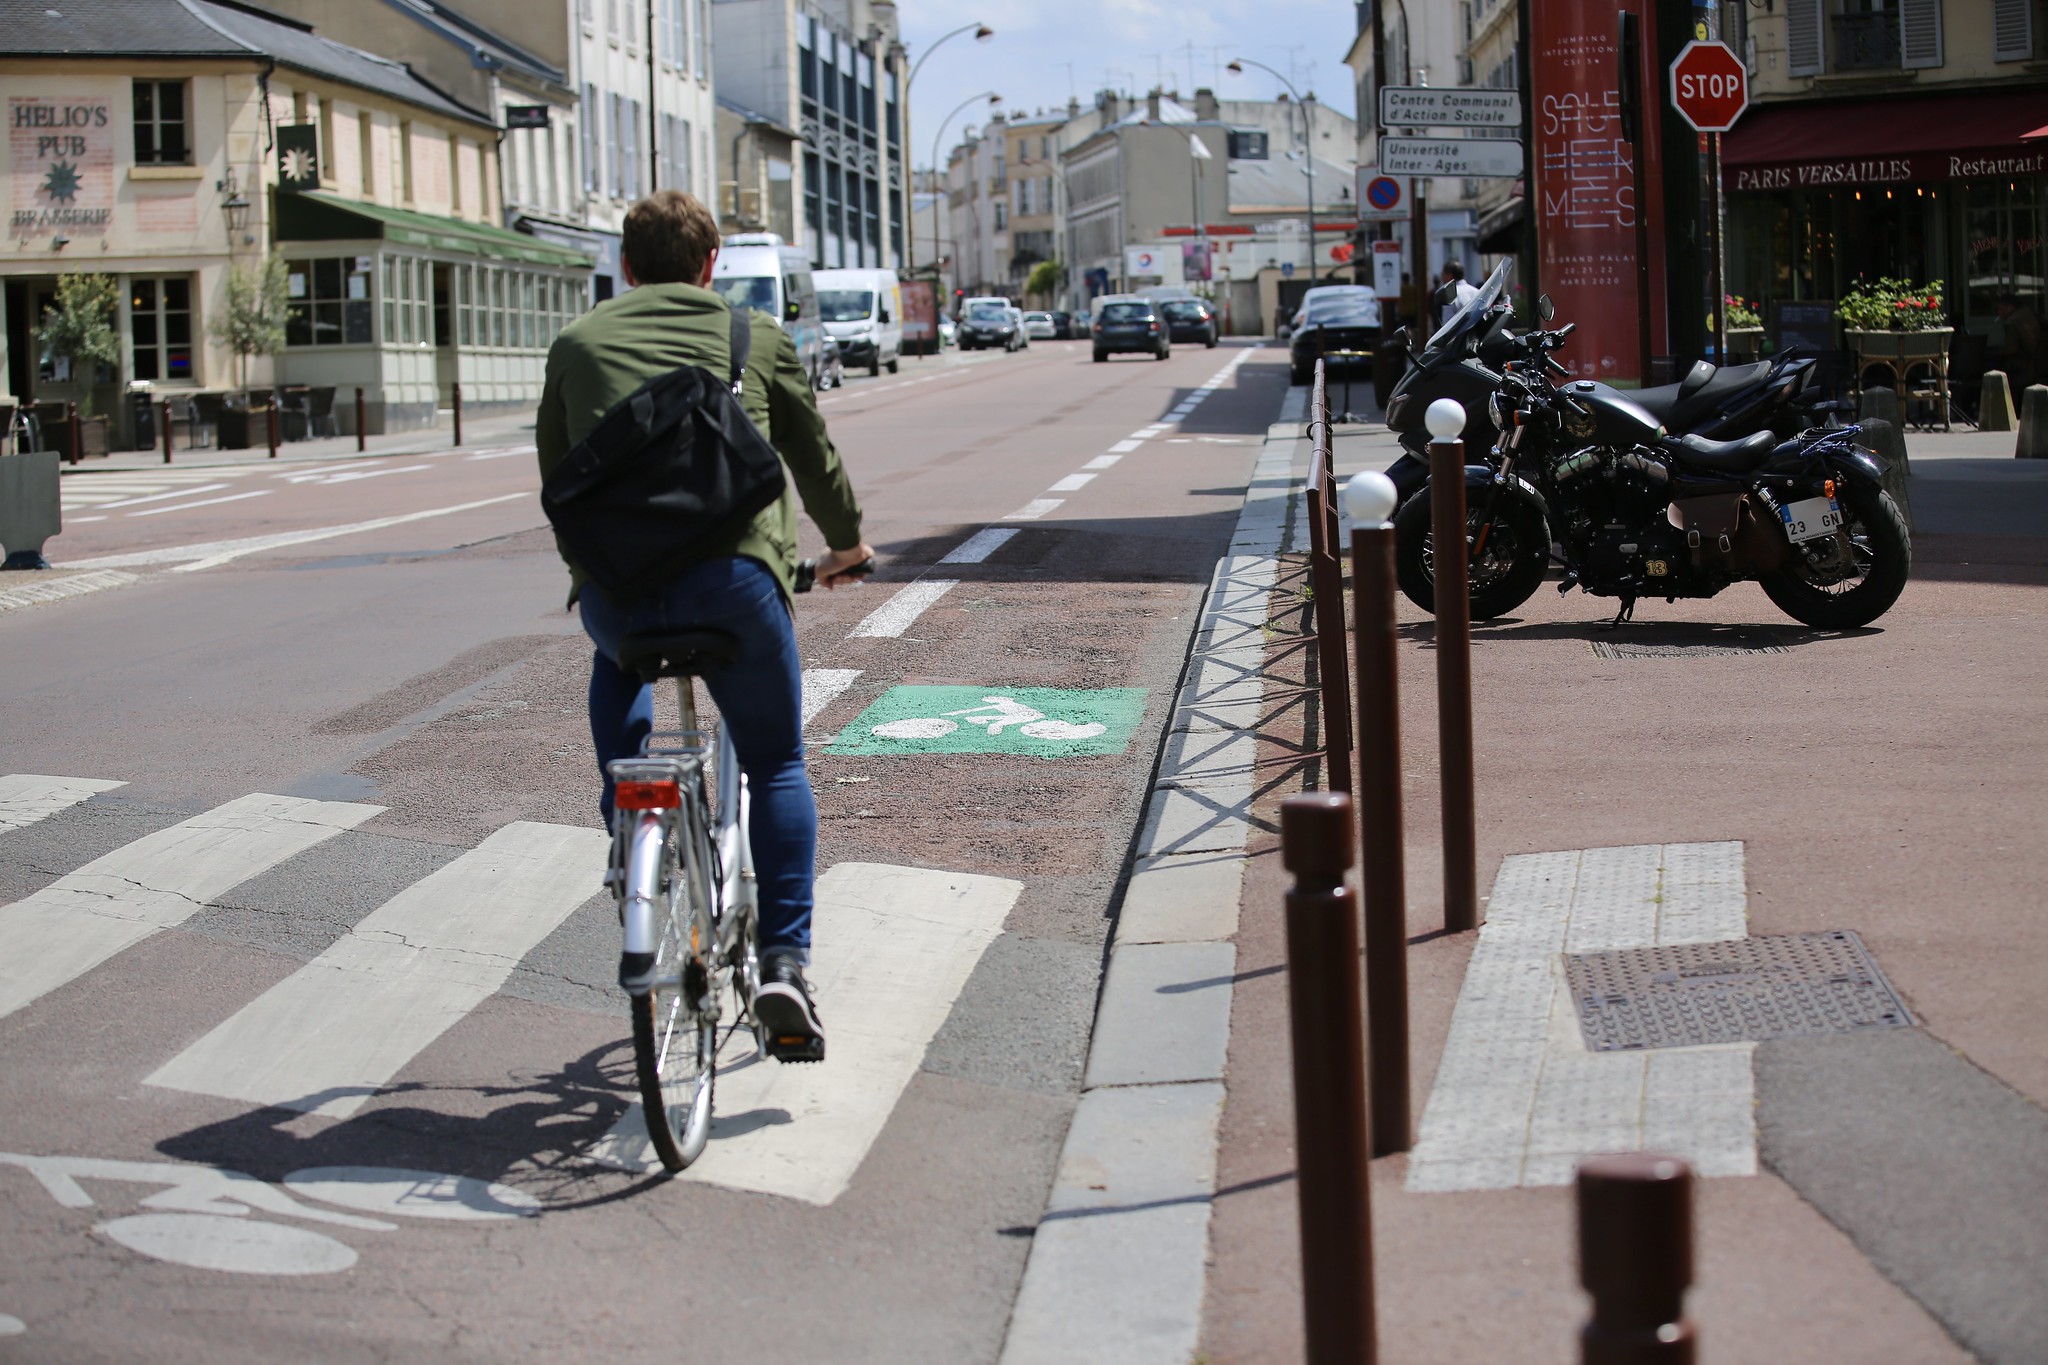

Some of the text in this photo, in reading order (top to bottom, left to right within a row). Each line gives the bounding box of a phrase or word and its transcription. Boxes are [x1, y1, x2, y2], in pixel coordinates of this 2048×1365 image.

[1542, 45, 1619, 57] INTERNATION
[1681, 74, 1739, 99] STOP
[1390, 93, 1513, 108] Centre Communal
[15, 105, 108, 129] HELIO'S
[1390, 109, 1506, 122] d'Action Sociale
[38, 136, 87, 158] PUB
[1389, 143, 1460, 157] Université
[1389, 158, 1422, 171] Inter
[1434, 158, 1468, 173] Ages
[1737, 159, 1912, 190] PARIS VERSAILLES
[14, 207, 113, 228] BRASSERIE
[1558, 254, 1594, 264] GRAND
[1560, 277, 1620, 286] MARS 2020
[1789, 512, 1840, 536] 23 GN
